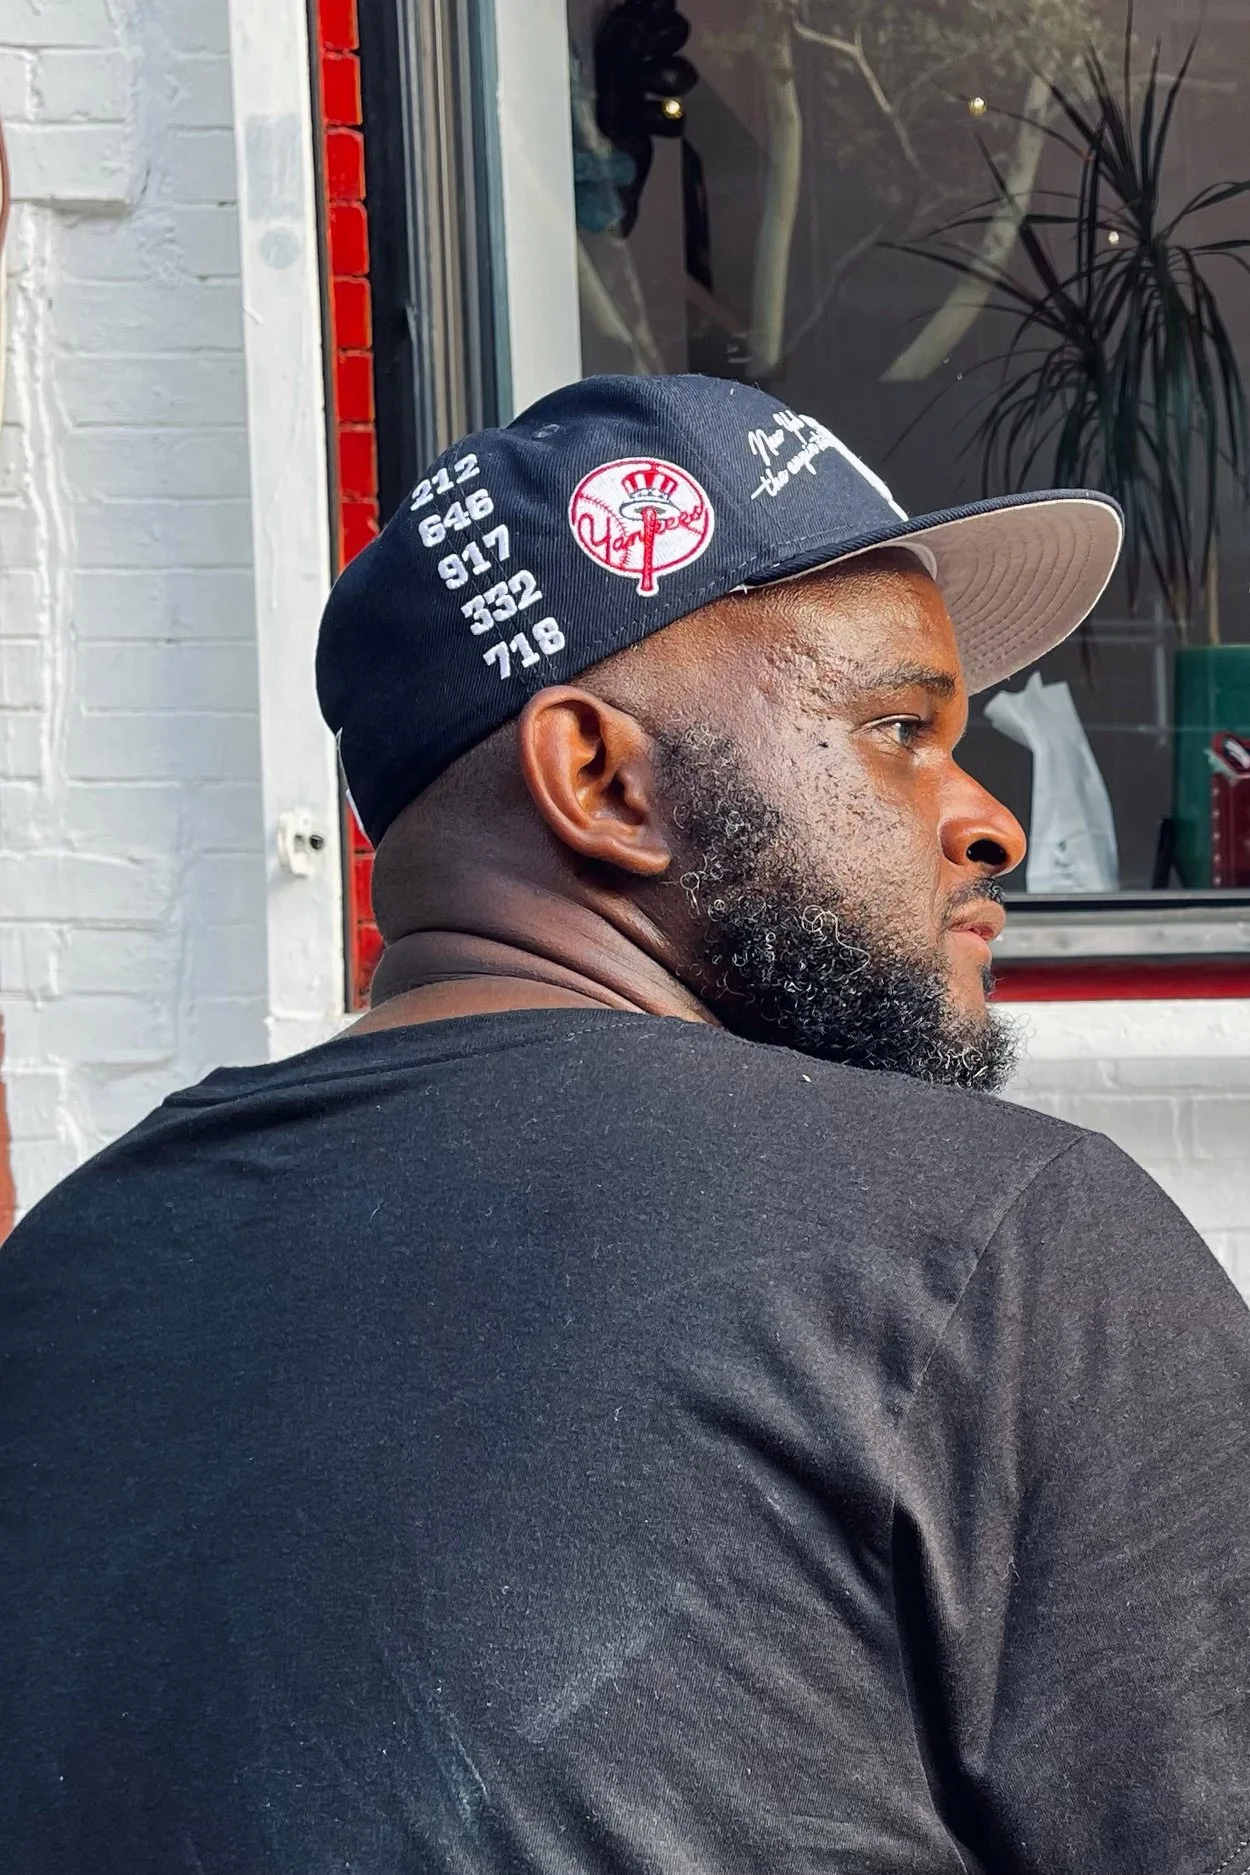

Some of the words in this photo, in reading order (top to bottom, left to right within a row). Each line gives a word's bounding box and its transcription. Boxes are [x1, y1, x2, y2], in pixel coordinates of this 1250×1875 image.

[410, 453, 481, 512] 212
[418, 487, 495, 549] 646
[578, 505, 704, 565] Yankees
[437, 523, 510, 590] 917
[460, 569, 543, 637] 332
[483, 616, 566, 680] 718
